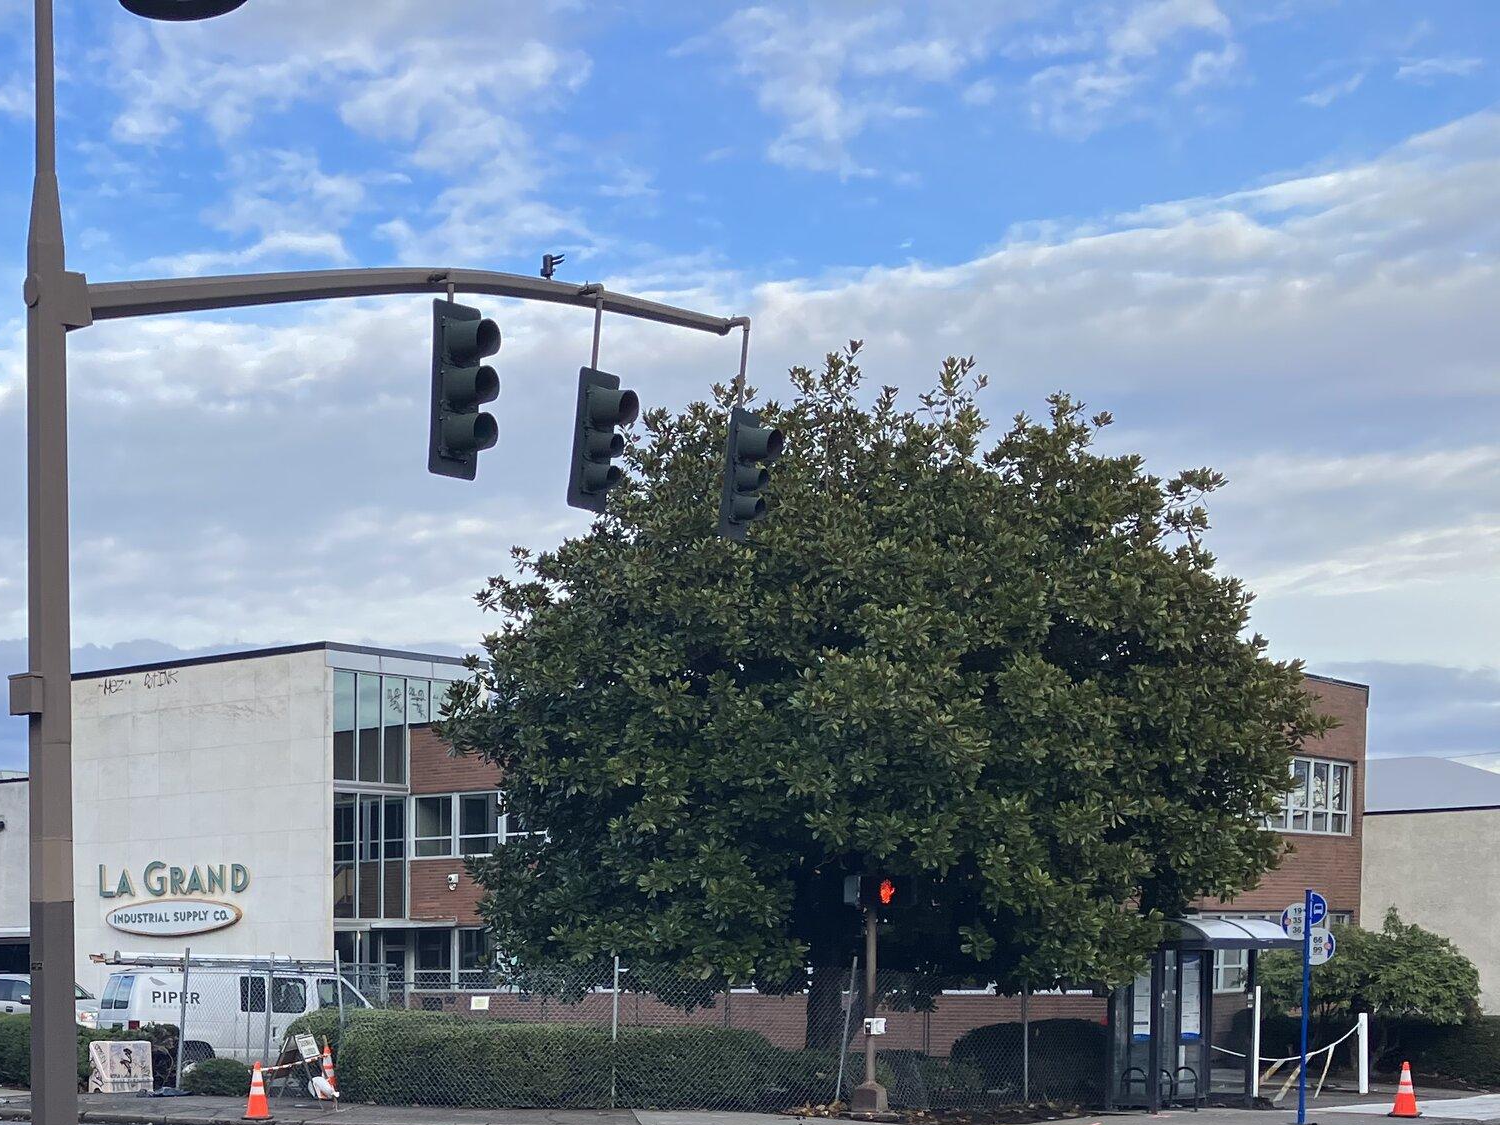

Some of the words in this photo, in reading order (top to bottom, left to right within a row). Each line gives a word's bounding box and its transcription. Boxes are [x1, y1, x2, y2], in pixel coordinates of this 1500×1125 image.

[98, 863, 135, 898] LA
[143, 860, 251, 897] GRAND
[113, 910, 169, 924] INDUSTRIAL
[173, 909, 209, 922] SUPPLY
[213, 910, 229, 921] CO.
